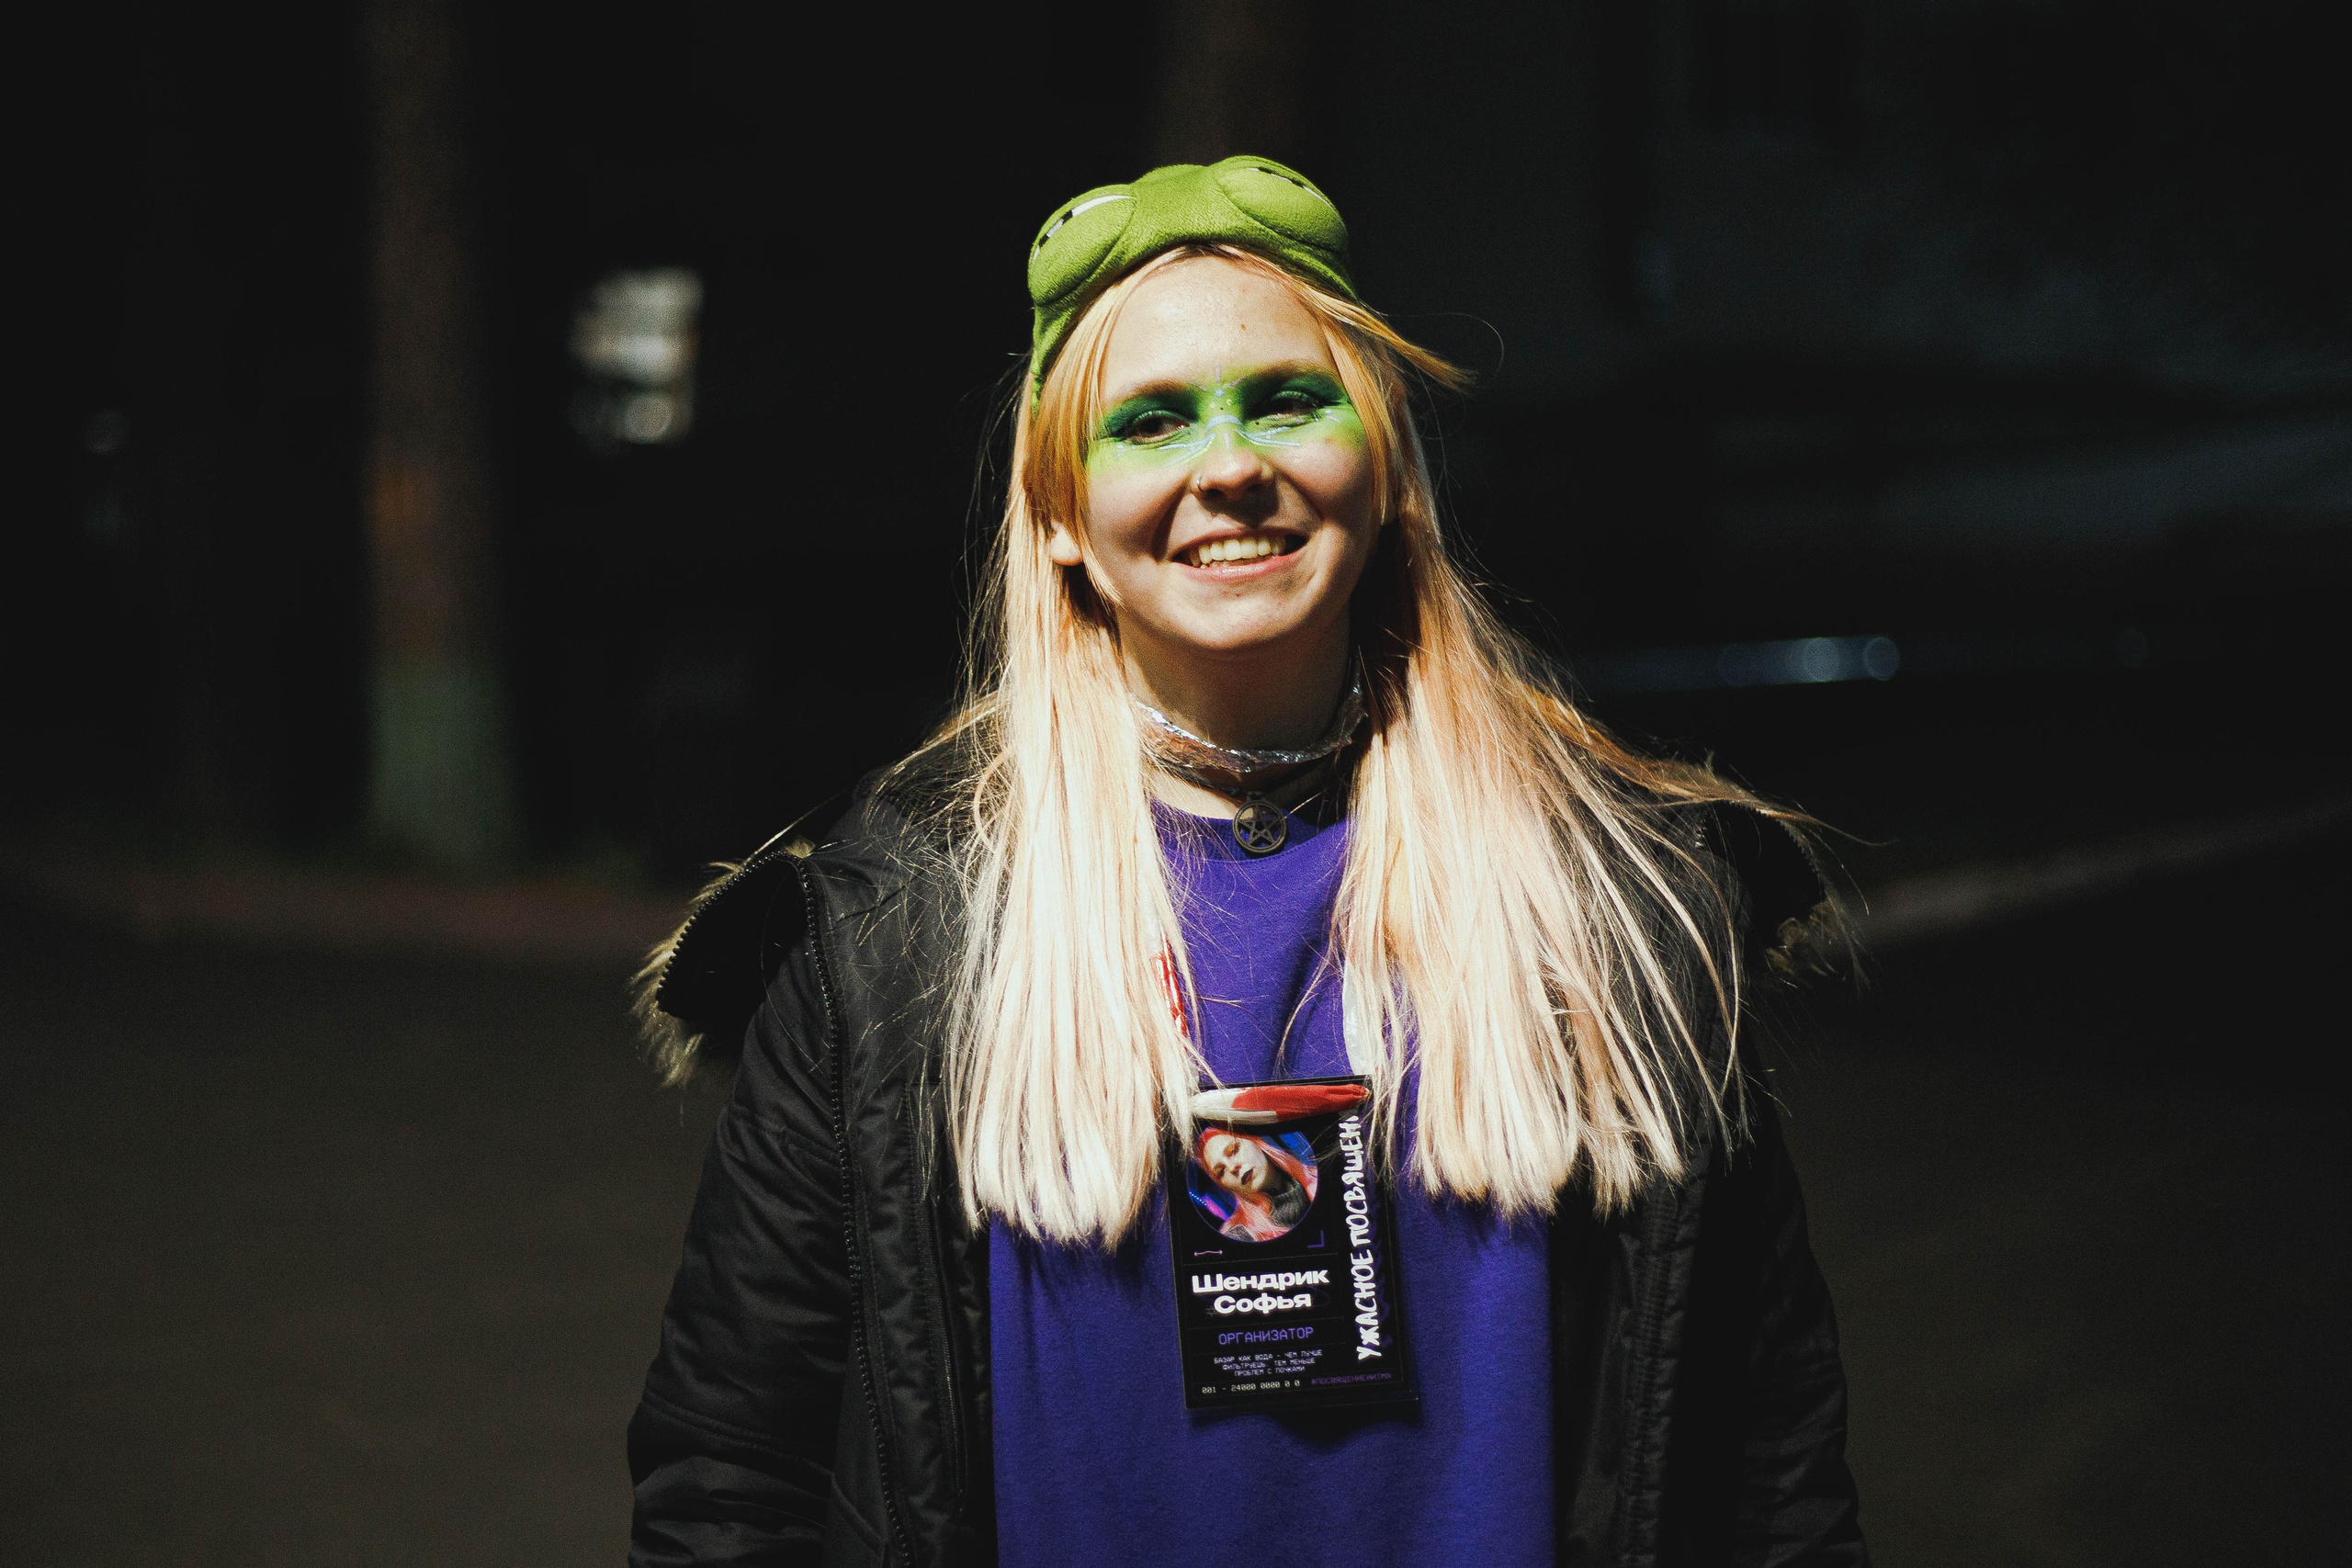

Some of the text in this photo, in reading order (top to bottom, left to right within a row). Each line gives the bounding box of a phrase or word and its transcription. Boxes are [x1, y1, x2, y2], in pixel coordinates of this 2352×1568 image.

[1192, 1269, 1330, 1293] Шендрик
[1214, 1292, 1313, 1314] Софья
[1350, 1248, 1383, 1361] УЖАСНОЕ
[1217, 1325, 1314, 1346] ОРГАНИЗАТОР
[1214, 1356, 1236, 1364] БАЗАР
[1254, 1353, 1273, 1361] ВОДА
[1290, 1358, 1316, 1366] МЕНЬШЕ
[1234, 1368, 1264, 1377] ПРОБЛЕМ
[1275, 1366, 1306, 1374] ПОЧКАМИ
[1202, 1386, 1216, 1394] 001
[1230, 1382, 1256, 1392] 24000
[1260, 1381, 1281, 1390] 0000
[1284, 1380, 1290, 1388] 0
[1295, 1379, 1300, 1387] 0
